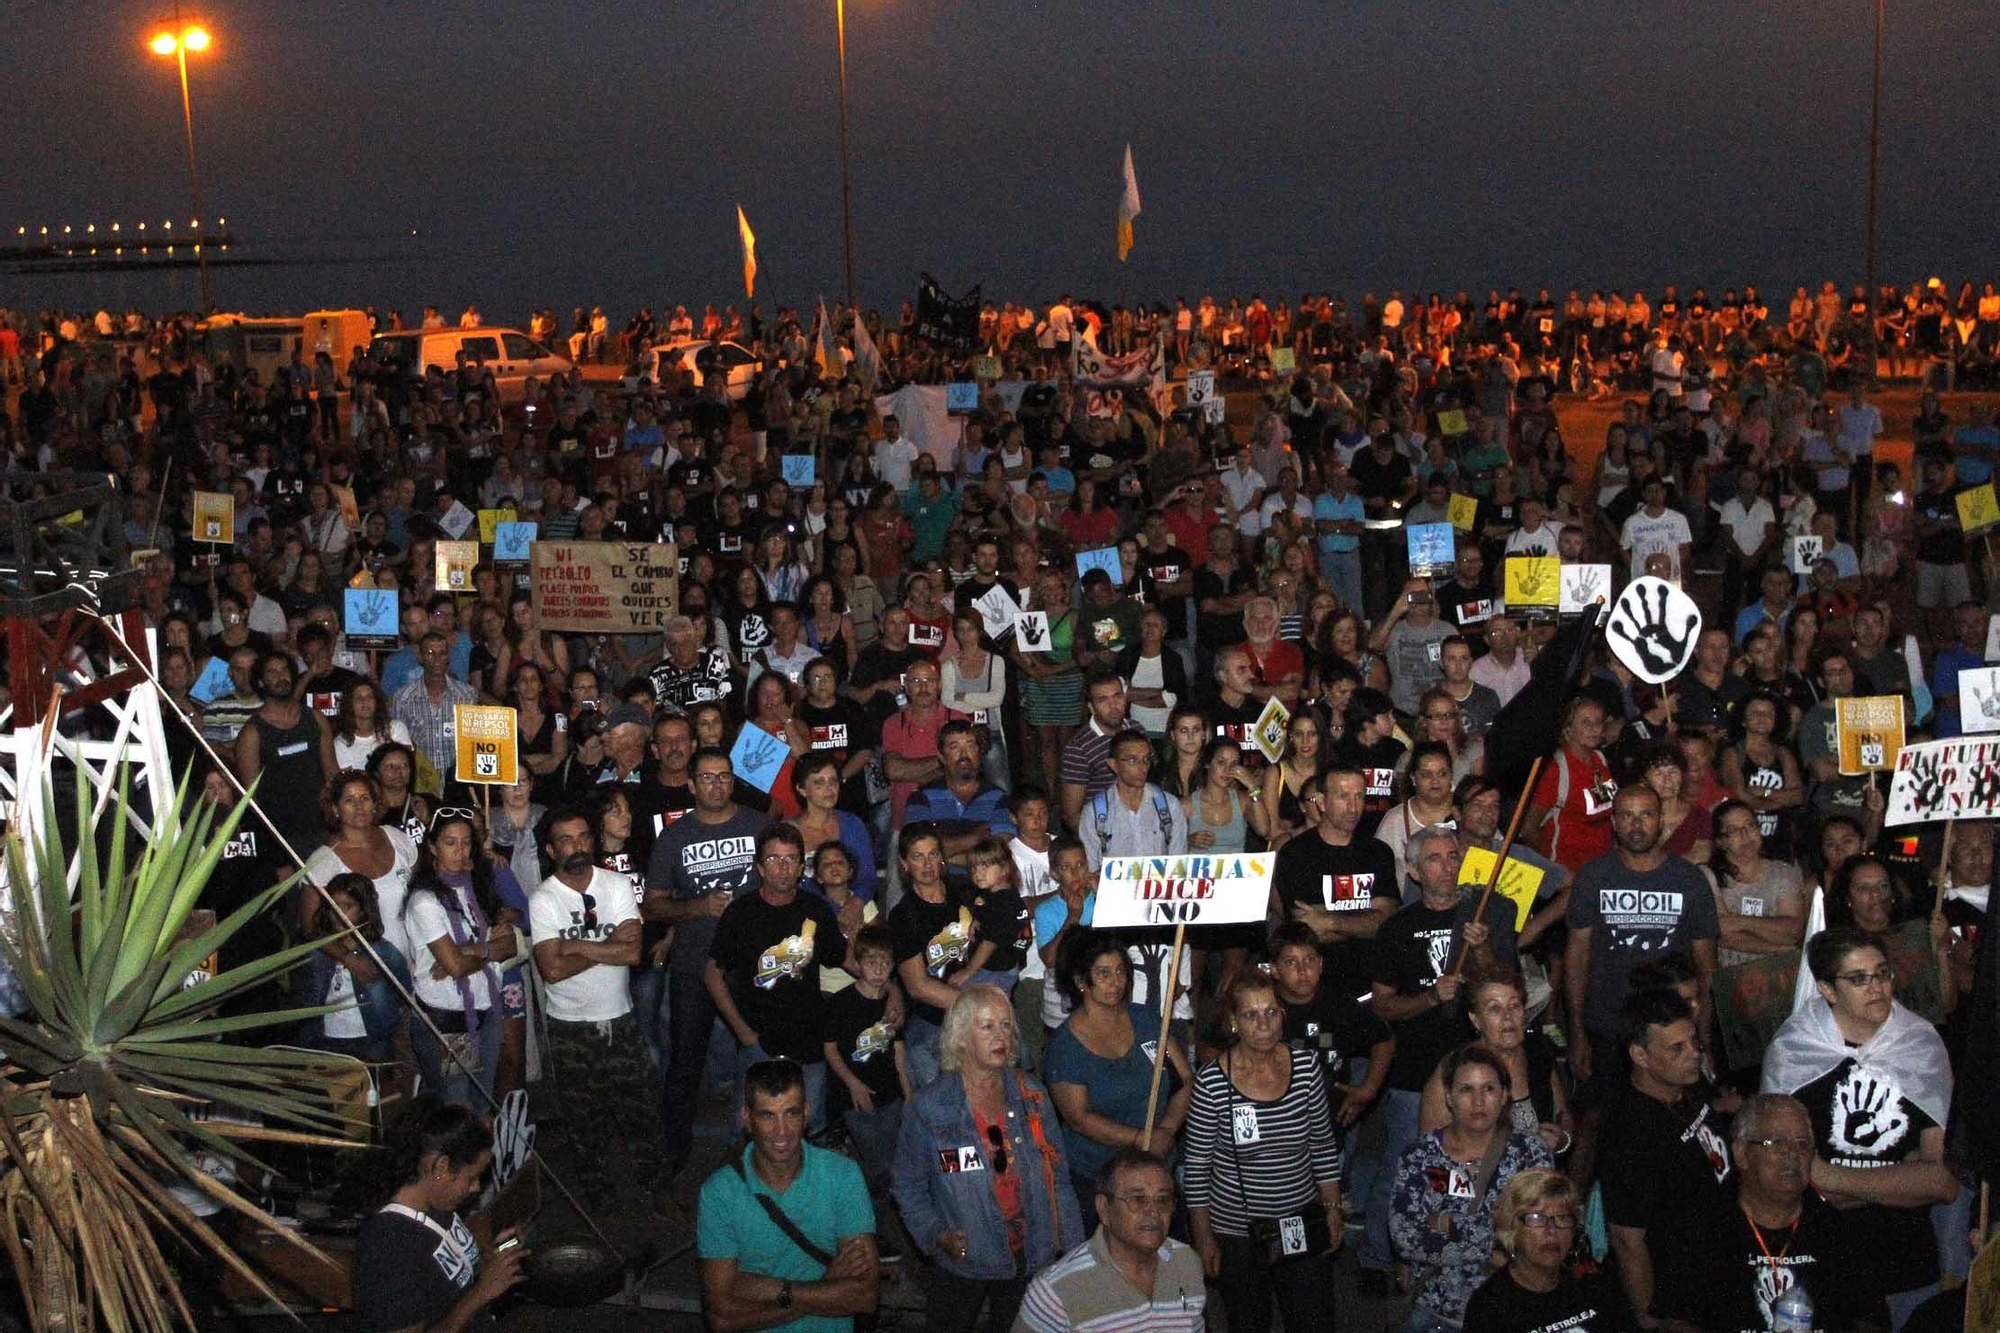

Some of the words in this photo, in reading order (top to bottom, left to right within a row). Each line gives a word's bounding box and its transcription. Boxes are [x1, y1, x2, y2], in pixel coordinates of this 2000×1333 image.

[539, 565, 591, 581] PETROLEO
[612, 565, 627, 579] EL
[635, 565, 673, 579] CAMBIO
[631, 581, 655, 595] QUE
[622, 595, 672, 608] QUIERES
[629, 611, 664, 626] VER
[473, 720, 508, 730] REPSOL
[811, 738, 848, 750] anzarote
[1861, 733, 1882, 744] NO
[476, 742, 496, 753] NO
[683, 843, 716, 866] NO
[719, 838, 756, 857] OIL
[1105, 856, 1266, 881] CANARIAS
[1142, 878, 1215, 901] DICE
[1601, 892, 1638, 911] NO
[1642, 893, 1682, 912] OIL
[570, 911, 582, 924] I
[1152, 901, 1201, 923] NO
